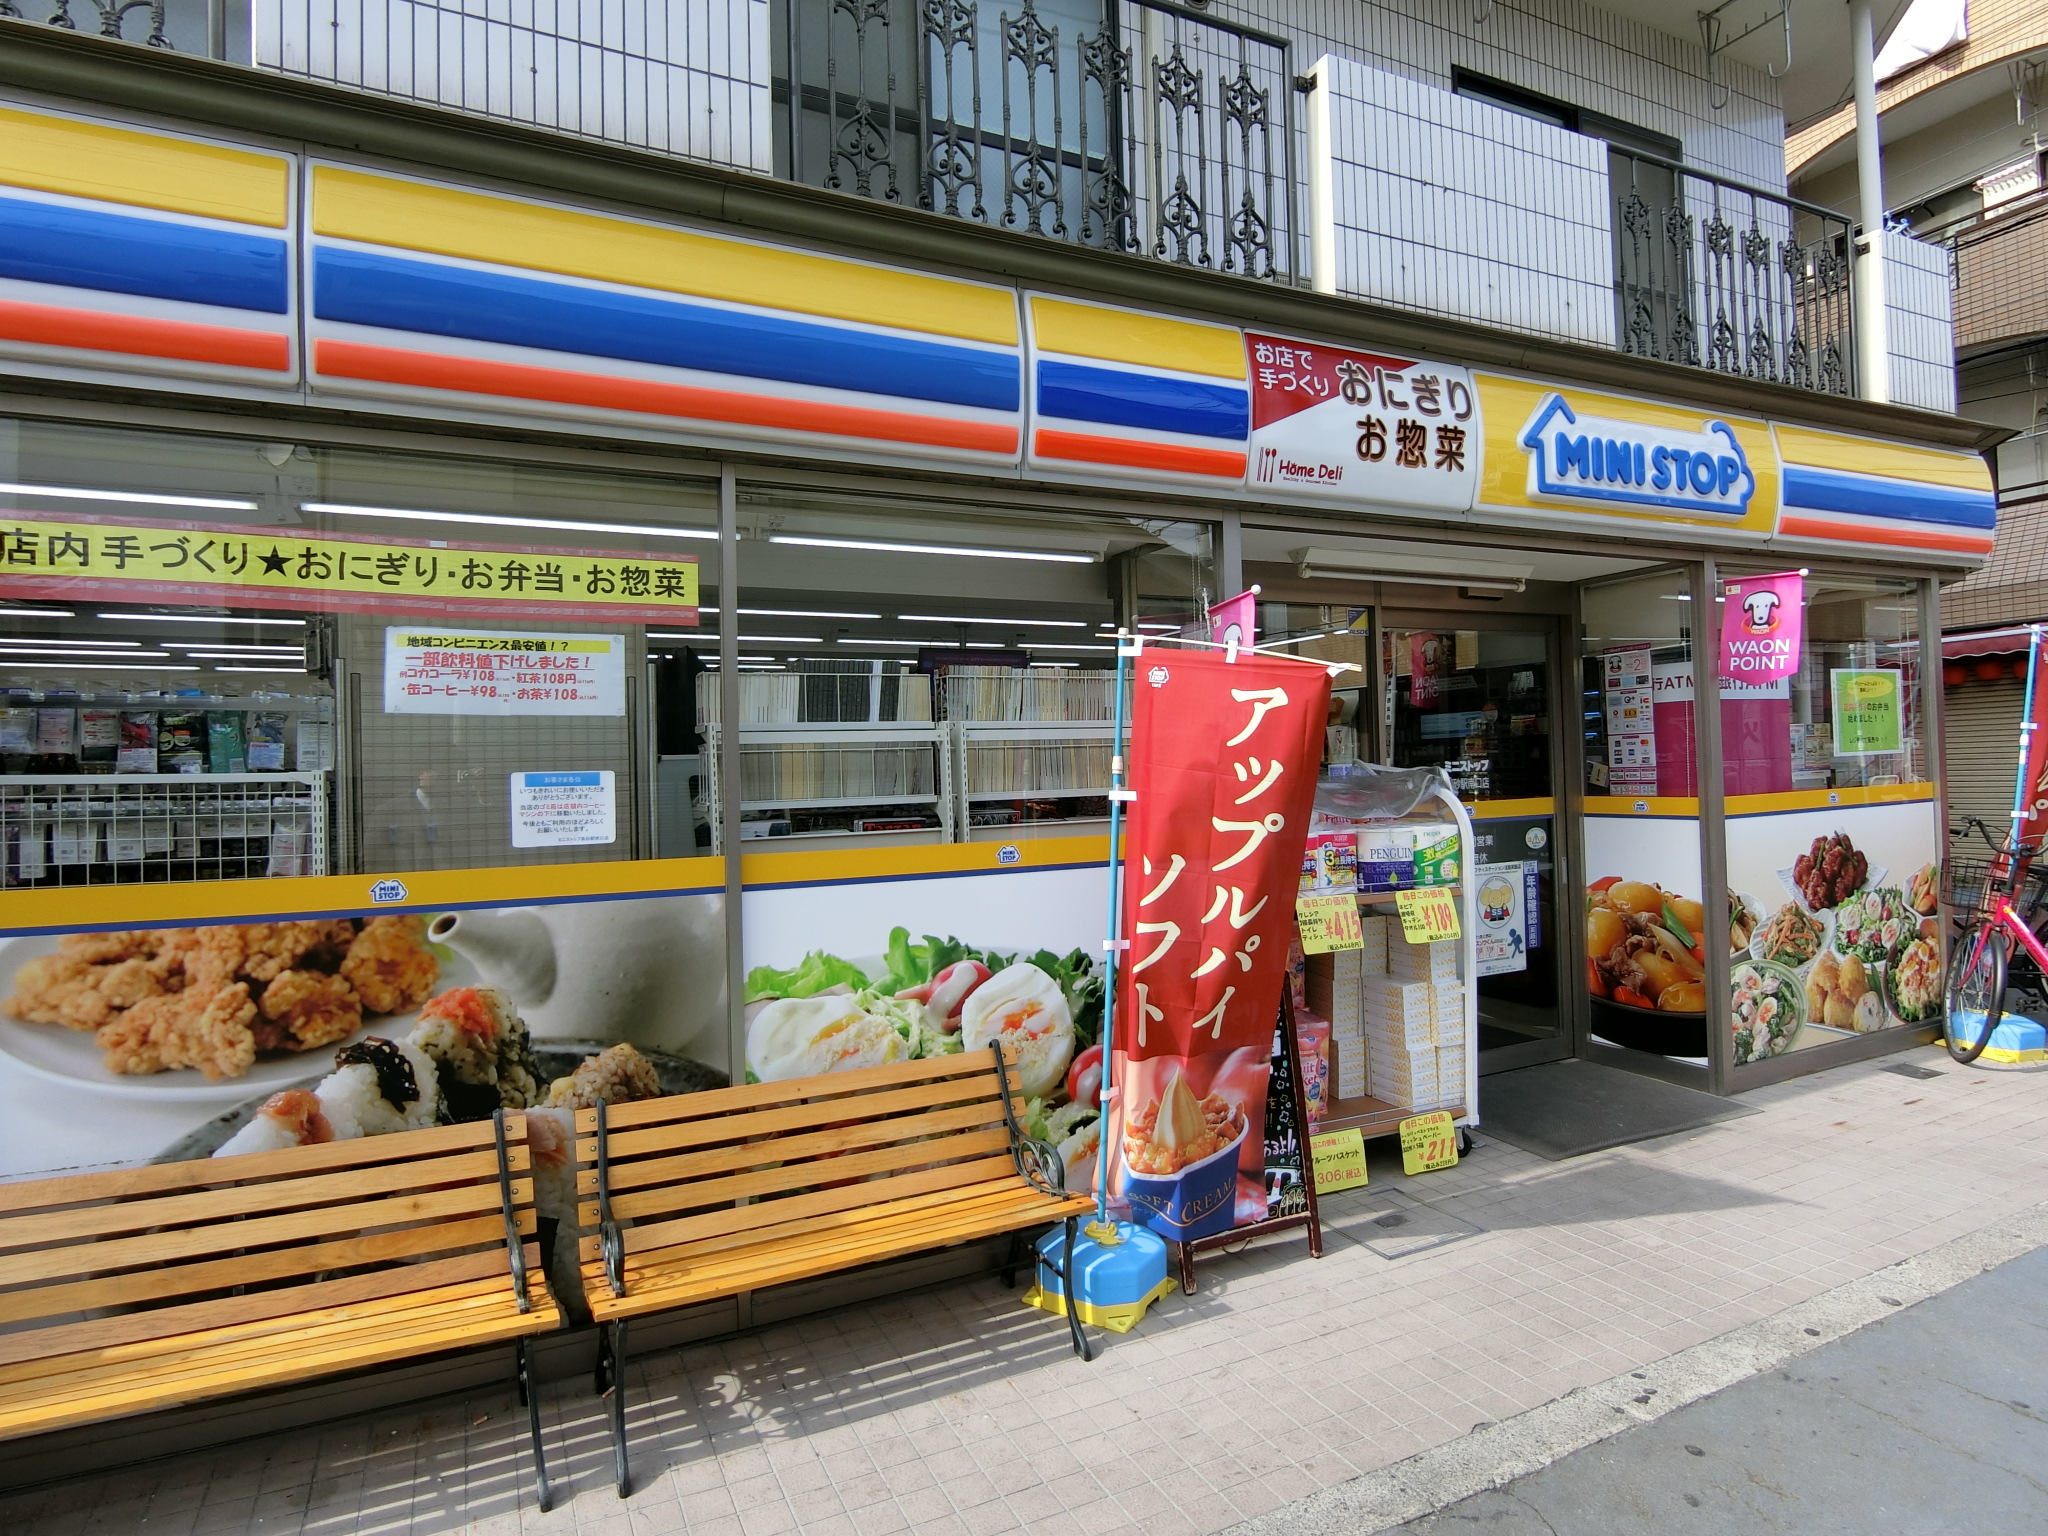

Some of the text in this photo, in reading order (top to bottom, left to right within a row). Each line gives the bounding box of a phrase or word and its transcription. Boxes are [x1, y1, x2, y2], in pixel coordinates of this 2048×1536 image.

[1255, 342, 1313, 371] お店で
[1259, 368, 1329, 397] 手づくり
[1335, 359, 1473, 422] おにぎり
[1356, 413, 1467, 473] お惣菜
[1279, 459, 1343, 481] Home Deli
[1555, 431, 1740, 497] MINI STOP
[1728, 638, 1790, 655] WAON
[1730, 655, 1789, 672] POINT
[1444, 759, 1489, 772] ミニストップ
[1190, 686, 1289, 1039] アップルパイ
[1370, 846, 1413, 860] PENGUIN
[1303, 896, 1349, 908] 毎日この価格
[1403, 889, 1445, 901] 毎日この価格
[1132, 853, 1187, 1048] ソフト
[1405, 1113, 1446, 1130] 毎日この価格
[1312, 1149, 1359, 1164] ルーツバスケット
[1128, 1176, 1235, 1223] SOFT CREAM
